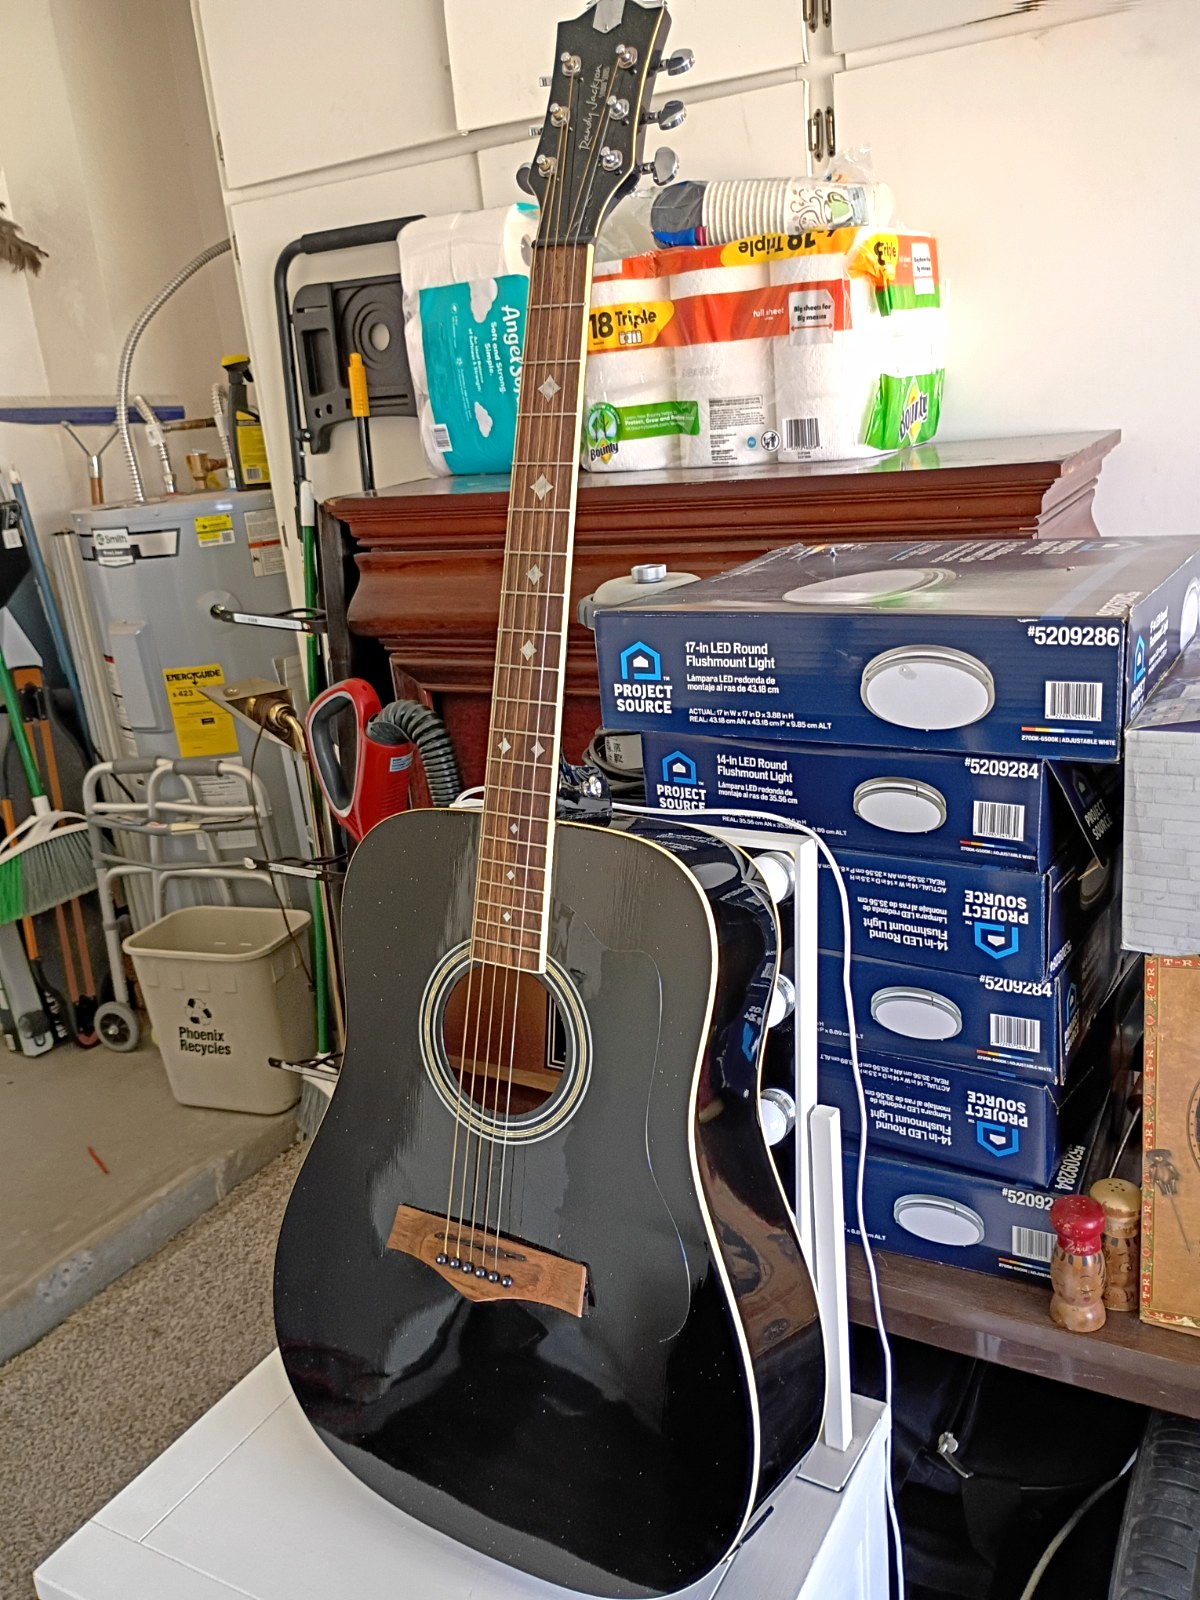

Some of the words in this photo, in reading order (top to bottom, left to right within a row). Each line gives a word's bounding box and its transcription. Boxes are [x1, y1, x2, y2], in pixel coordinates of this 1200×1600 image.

[586, 63, 603, 110] Jackson
[579, 112, 600, 150] Randy
[738, 235, 784, 257] Triple
[753, 308, 765, 318] full
[765, 307, 785, 317] sheet
[589, 312, 614, 339] 18
[614, 309, 657, 329] Triple
[501, 305, 523, 363] Angel
[492, 342, 501, 361] and
[484, 343, 495, 377] Simple.
[900, 394, 928, 441] Bounty
[590, 442, 619, 461] Bounty
[104, 534, 128, 545] Smith
[1027, 625, 1120, 646] #5209286
[685, 641, 709, 654] 17-in
[710, 641, 732, 654] LED
[733, 642, 769, 655] Round
[685, 654, 747, 668] Flushmount
[748, 656, 776, 671] Light
[686, 674, 718, 684] Lámpara
[718, 674, 733, 683] LED
[734, 675, 765, 685] redonda
[766, 676, 776, 685] de
[613, 683, 673, 699] PROJECT
[687, 683, 715, 692] montaje
[716, 684, 723, 692] al
[737, 684, 747, 693] de
[747, 685, 766, 694] 43.18
[616, 698, 673, 714] SOURCE
[730, 709, 737, 717] W
[788, 712, 794, 720] H
[709, 716, 726, 724] 43.18
[736, 717, 747, 725] AN
[751, 718, 769, 726] 43.18
[818, 722, 832, 730] ALT
[1021, 734, 1059, 743] 2700K-6500K
[1061, 737, 1098, 746] ADJUSTABLE
[716, 754, 738, 766] 14-in
[738, 756, 756, 767] LED
[757, 758, 788, 771] Round
[964, 757, 1039, 780] #5209284
[717, 765, 769, 780] Flushmount
[770, 771, 793, 784] Light
[656, 784, 707, 801] PROJECT
[718, 781, 745, 791] Lámpara
[745, 784, 758, 792] LED
[758, 786, 784, 795] redonda
[718, 789, 742, 798] montaje
[768, 794, 787, 803] 35.56
[659, 797, 706, 811] SOURCE
[1084, 799, 1106, 827] PROJECT
[1091, 813, 1114, 841] SOURCE
[869, 898, 888, 907] 35.56
[964, 889, 1027, 910] SOURCE
[862, 904, 871, 912] de
[872, 906, 900, 915] redonda
[901, 911, 915, 919] LED
[919, 905, 947, 915] montaje
[962, 904, 1029, 925] PROJECT
[863, 917, 887, 930] Light
[889, 921, 948, 940] Flushmount
[869, 929, 901, 943] Round
[903, 935, 922, 947] LED
[924, 938, 948, 951] 14-in
[1163, 958, 1193, 967] T-R
[979, 974, 1053, 997] #5209284
[1147, 967, 1155, 991] T-R
[179, 1026, 225, 1042] Phoenix
[180, 1039, 232, 1056] Recycles
[878, 1099, 906, 1109] redonda
[904, 1097, 916, 1105] ras
[907, 1105, 920, 1113] LED
[924, 1102, 951, 1112] montaje
[967, 1090, 1026, 1114] SOURCE
[870, 1108, 894, 1122] Light
[965, 1103, 1028, 1128] PROJECT
[876, 1120, 906, 1136] Round
[895, 1114, 952, 1135] Flushmount
[908, 1128, 927, 1140] LED
[929, 1133, 952, 1146] 14-in
[1054, 1145, 1086, 1191] #5209284
[1002, 1188, 1055, 1211] #52092
